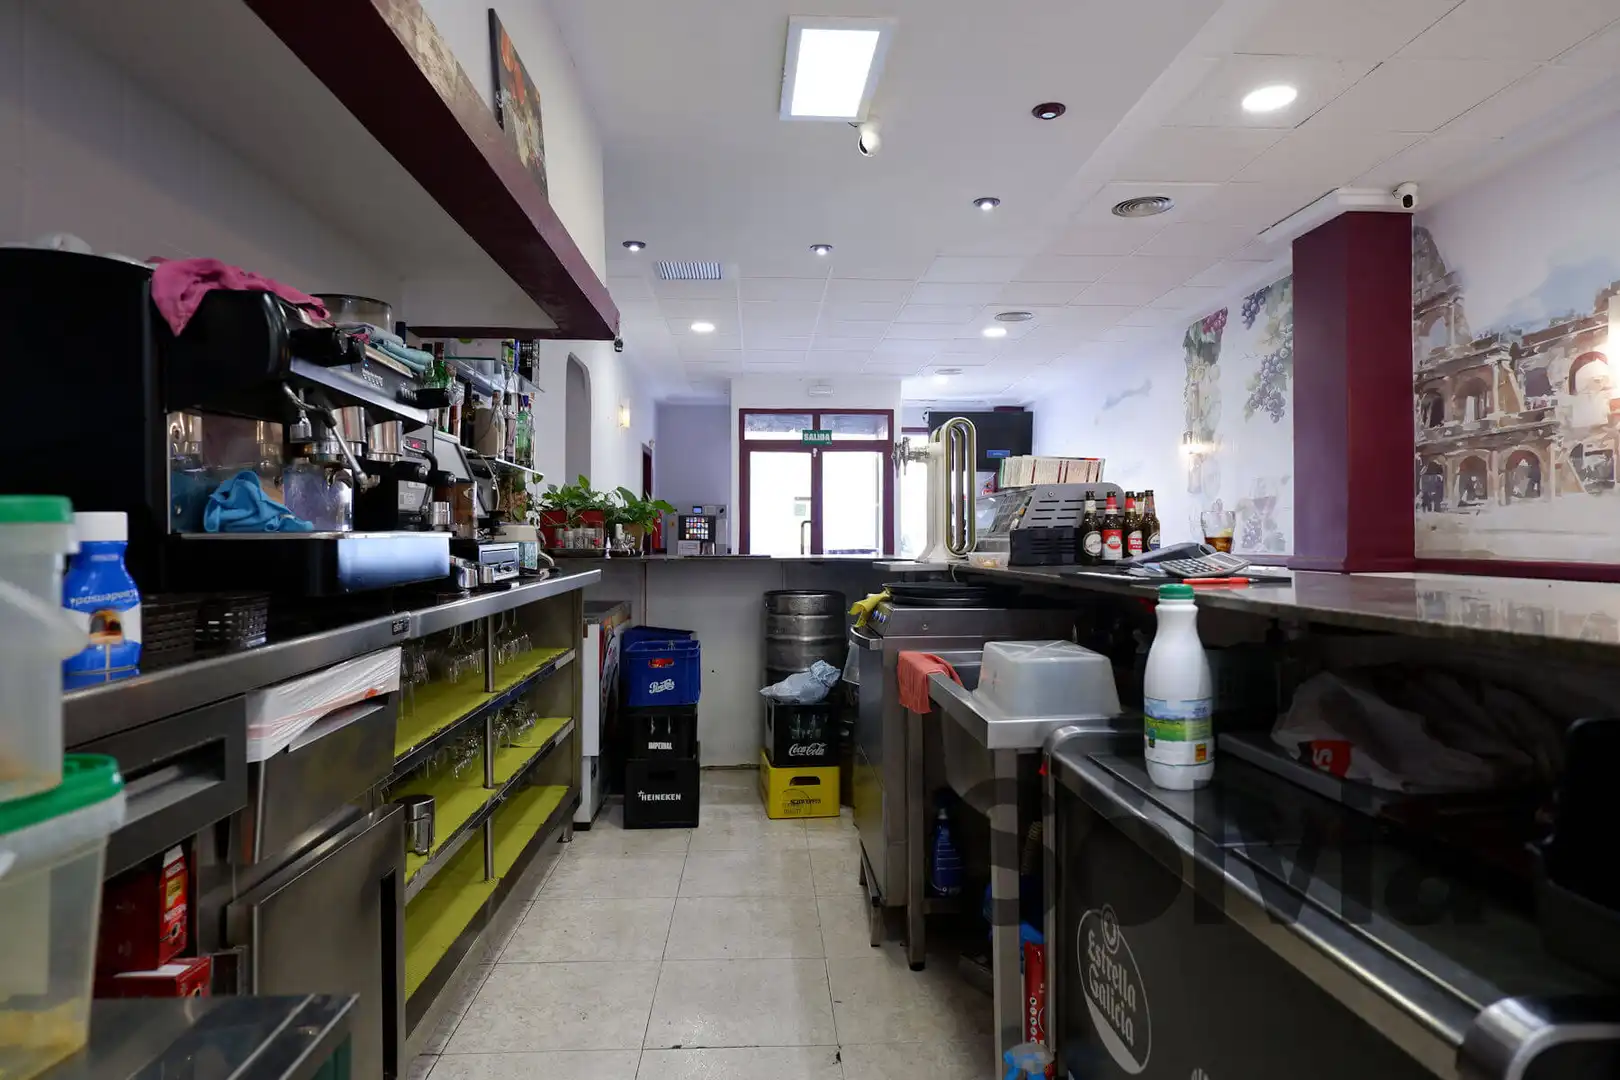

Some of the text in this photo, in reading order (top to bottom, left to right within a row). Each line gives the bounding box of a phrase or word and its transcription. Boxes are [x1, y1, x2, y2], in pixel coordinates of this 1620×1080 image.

[804, 433, 830, 441] SALIDA
[648, 742, 673, 750] IMPERIAL
[641, 793, 681, 801] HEINEKEN
[1088, 929, 1136, 1012] Estrella
[1089, 963, 1134, 1047] Galicia
